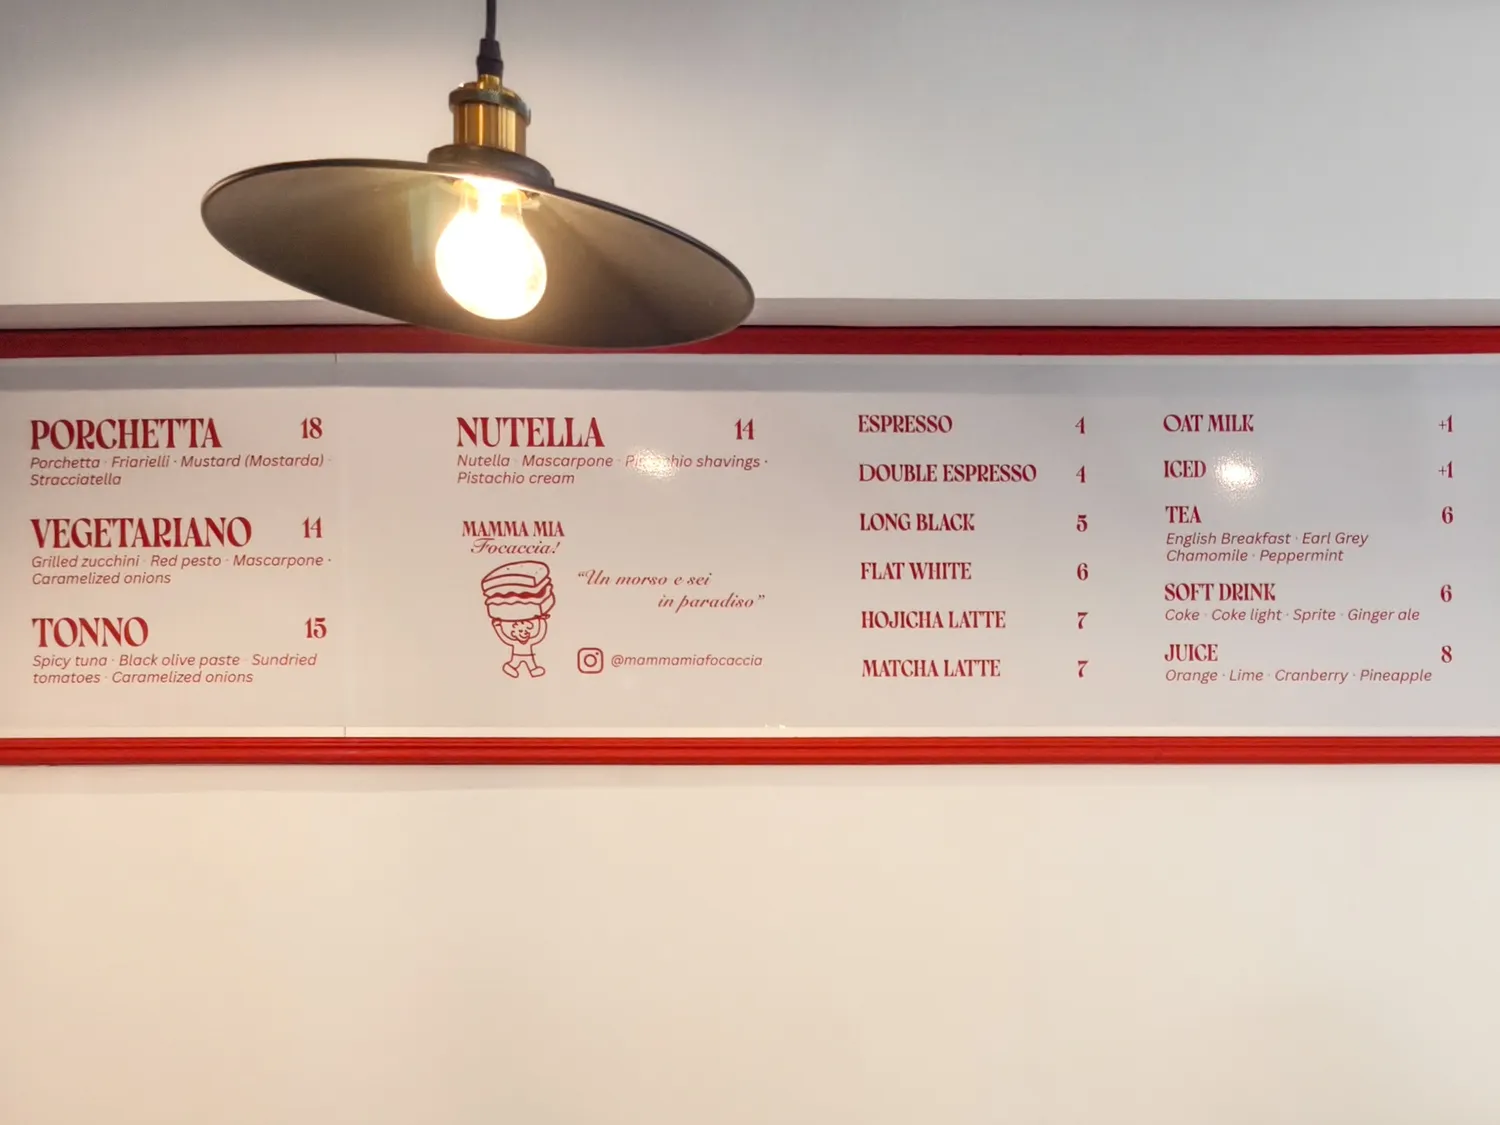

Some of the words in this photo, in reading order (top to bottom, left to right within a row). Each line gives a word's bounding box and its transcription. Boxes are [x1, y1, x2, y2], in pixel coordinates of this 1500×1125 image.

[859, 415, 952, 433] ESPRESSO
[1075, 417, 1085, 434] 4
[1163, 414, 1203, 432] OAT
[1208, 414, 1254, 432] MILK
[1439, 415, 1452, 432] +1
[31, 418, 222, 450] PORCHETTA
[301, 417, 323, 439] 18
[457, 417, 605, 447] NUTELLA
[735, 419, 754, 440] 14
[30, 457, 100, 469] Porchetta
[112, 455, 170, 468] Friarielli
[181, 454, 241, 467] Mustard
[245, 454, 324, 468] (Mostarda)
[457, 454, 510, 467] Nutella
[522, 455, 613, 470] Mascarpone
[696, 455, 760, 471] shavings
[1164, 460, 1206, 478] ICED
[1439, 461, 1453, 478] +1
[30, 473, 121, 486] Stracciatella
[457, 471, 525, 484] Pistachio
[529, 475, 574, 484] cream
[859, 464, 937, 482] DOUBLE
[943, 464, 1037, 482] ESPRESSO
[1076, 466, 1085, 483] 4
[860, 513, 911, 531] LONG
[916, 513, 975, 531] BLACK
[1076, 515, 1088, 532] 5
[1165, 506, 1201, 523] TEA
[1442, 506, 1453, 524] 6
[30, 517, 252, 548] VEGETARIANO
[303, 517, 322, 538] 14
[462, 521, 529, 537] MAMMA
[533, 521, 565, 537] MIA
[471, 537, 560, 555] Focaccia!
[1166, 532, 1216, 548] English
[1221, 532, 1291, 544] Breakfast
[1302, 532, 1331, 544] Earl
[1335, 532, 1368, 547] Grey
[32, 556, 78, 568] Grilled
[81, 555, 140, 567] zucchini
[151, 555, 178, 567] Red
[181, 556, 221, 569] pesto
[233, 554, 324, 569] Mascarpone
[1167, 549, 1248, 561] Chamomile
[1260, 549, 1344, 564] Peppermint
[32, 572, 120, 585] Caramelized
[124, 572, 171, 584] onions
[614, 576, 668, 586] morso
[673, 576, 684, 586] e
[687, 573, 712, 585] sei
[861, 562, 905, 580] FLAT
[909, 562, 971, 580] WHITE
[1077, 563, 1088, 581] 6
[658, 595, 673, 607] in
[1165, 583, 1214, 601] SOFT
[1219, 583, 1275, 601] DRINK
[1440, 584, 1452, 602] 6
[862, 611, 944, 628] HOJICHA
[949, 611, 1005, 628] LATTE
[1078, 612, 1088, 629] 7
[1165, 608, 1200, 621] Coke
[1212, 609, 1246, 621] Coke
[1250, 608, 1282, 624] light
[1293, 609, 1336, 624] Sprite
[1348, 608, 1395, 624] Ginger
[1398, 608, 1420, 620] ale
[32, 617, 148, 648] TONNO
[306, 618, 327, 638] 15
[33, 655, 71, 670] Spicy
[76, 656, 107, 667] tuna
[119, 654, 158, 666] Black
[162, 654, 195, 666] olive
[199, 655, 240, 669] paste
[252, 653, 317, 666] Sundried
[611, 654, 762, 668] @mammamiafocaccia
[1164, 644, 1218, 661] JUICE
[1441, 645, 1452, 663] 8
[862, 660, 939, 677] MATCHA
[944, 659, 1000, 677] LATTE
[1078, 660, 1088, 678] 7
[1166, 669, 1218, 684] Orange
[1230, 669, 1263, 681] Lime
[1275, 669, 1349, 684] Cranberry
[1360, 669, 1432, 684] Pineapple
[33, 673, 101, 684] tomatoes
[112, 671, 202, 683] Caramelized
[205, 671, 254, 683] onions
